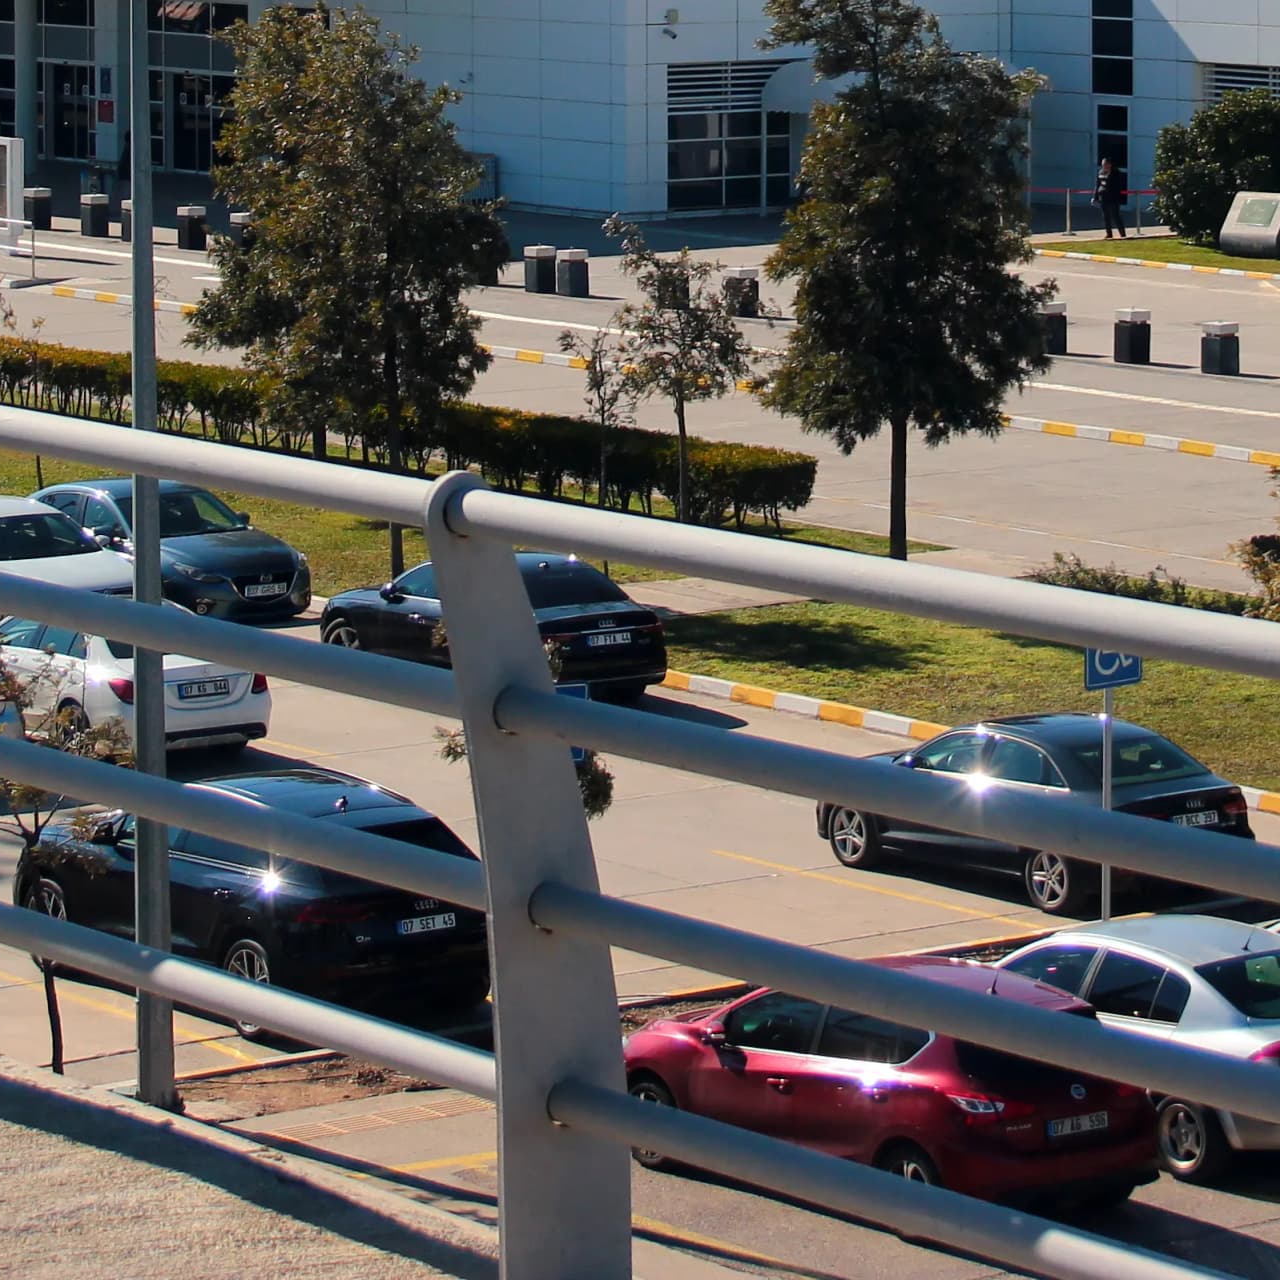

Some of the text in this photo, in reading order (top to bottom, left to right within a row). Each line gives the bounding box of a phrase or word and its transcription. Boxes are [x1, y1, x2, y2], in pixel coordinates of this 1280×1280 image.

[403, 914, 455, 933] 07 SET 45
[1053, 1121, 1065, 1134] 07
